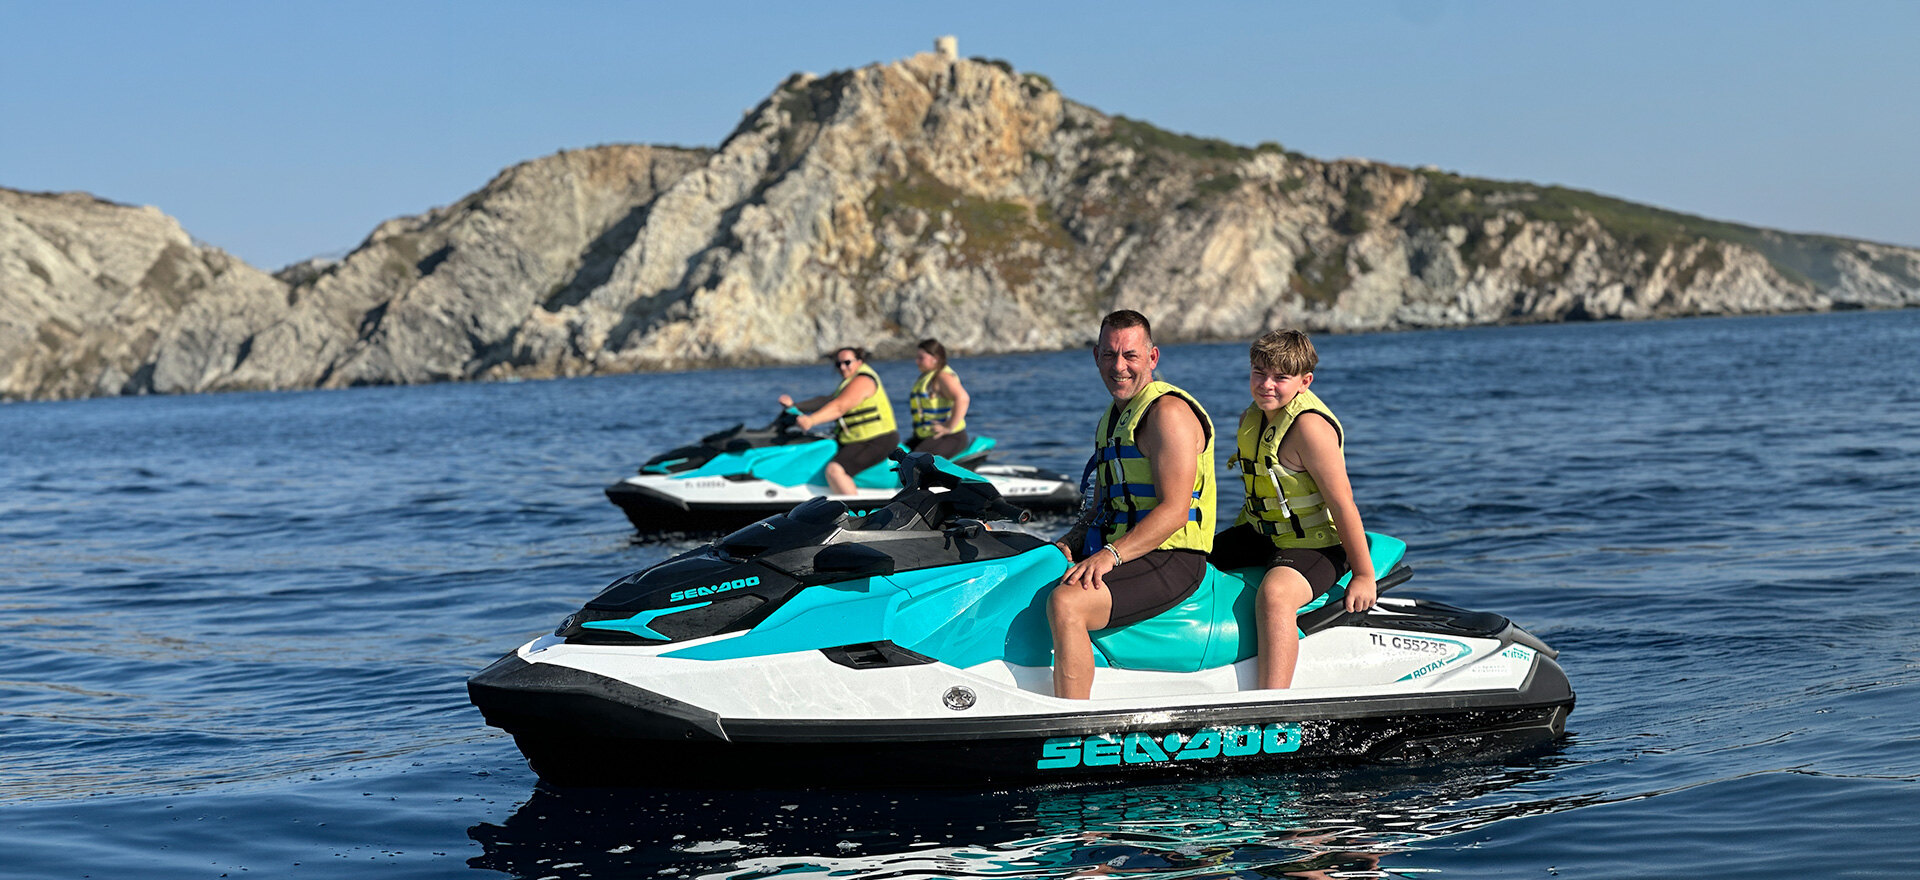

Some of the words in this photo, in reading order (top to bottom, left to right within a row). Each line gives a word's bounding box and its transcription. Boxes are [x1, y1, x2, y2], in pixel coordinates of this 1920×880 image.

[1369, 633, 1386, 647] TL
[1392, 637, 1447, 656] G55235
[1413, 659, 1446, 678] ROTAX
